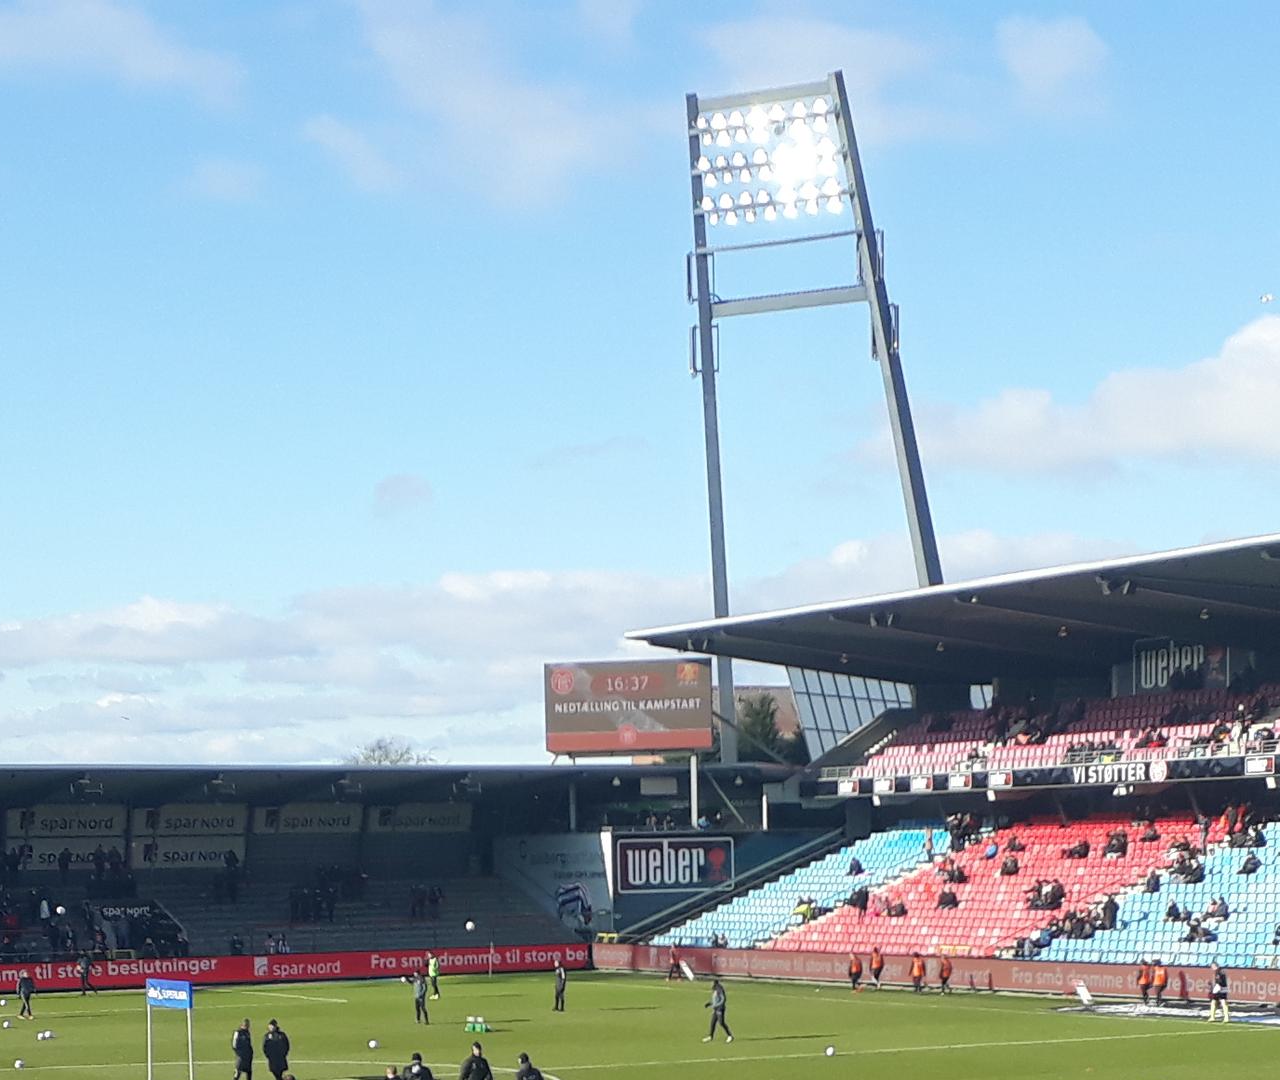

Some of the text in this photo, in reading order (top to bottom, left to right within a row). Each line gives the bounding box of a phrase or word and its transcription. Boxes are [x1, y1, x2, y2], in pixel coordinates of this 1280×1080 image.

[607, 676, 649, 691] 16:37
[555, 698, 701, 713] NEDTÆLLING TIL KAMPSTART
[1073, 763, 1145, 783] VI STØTTER
[40, 817, 75, 832] spar
[163, 851, 196, 864] spar
[627, 839, 705, 886] weber
[371, 953, 396, 969] Fra
[506, 947, 520, 962] til
[35, 963, 52, 980] til
[108, 957, 217, 978] beslutninger
[273, 960, 341, 978] spar Nord
